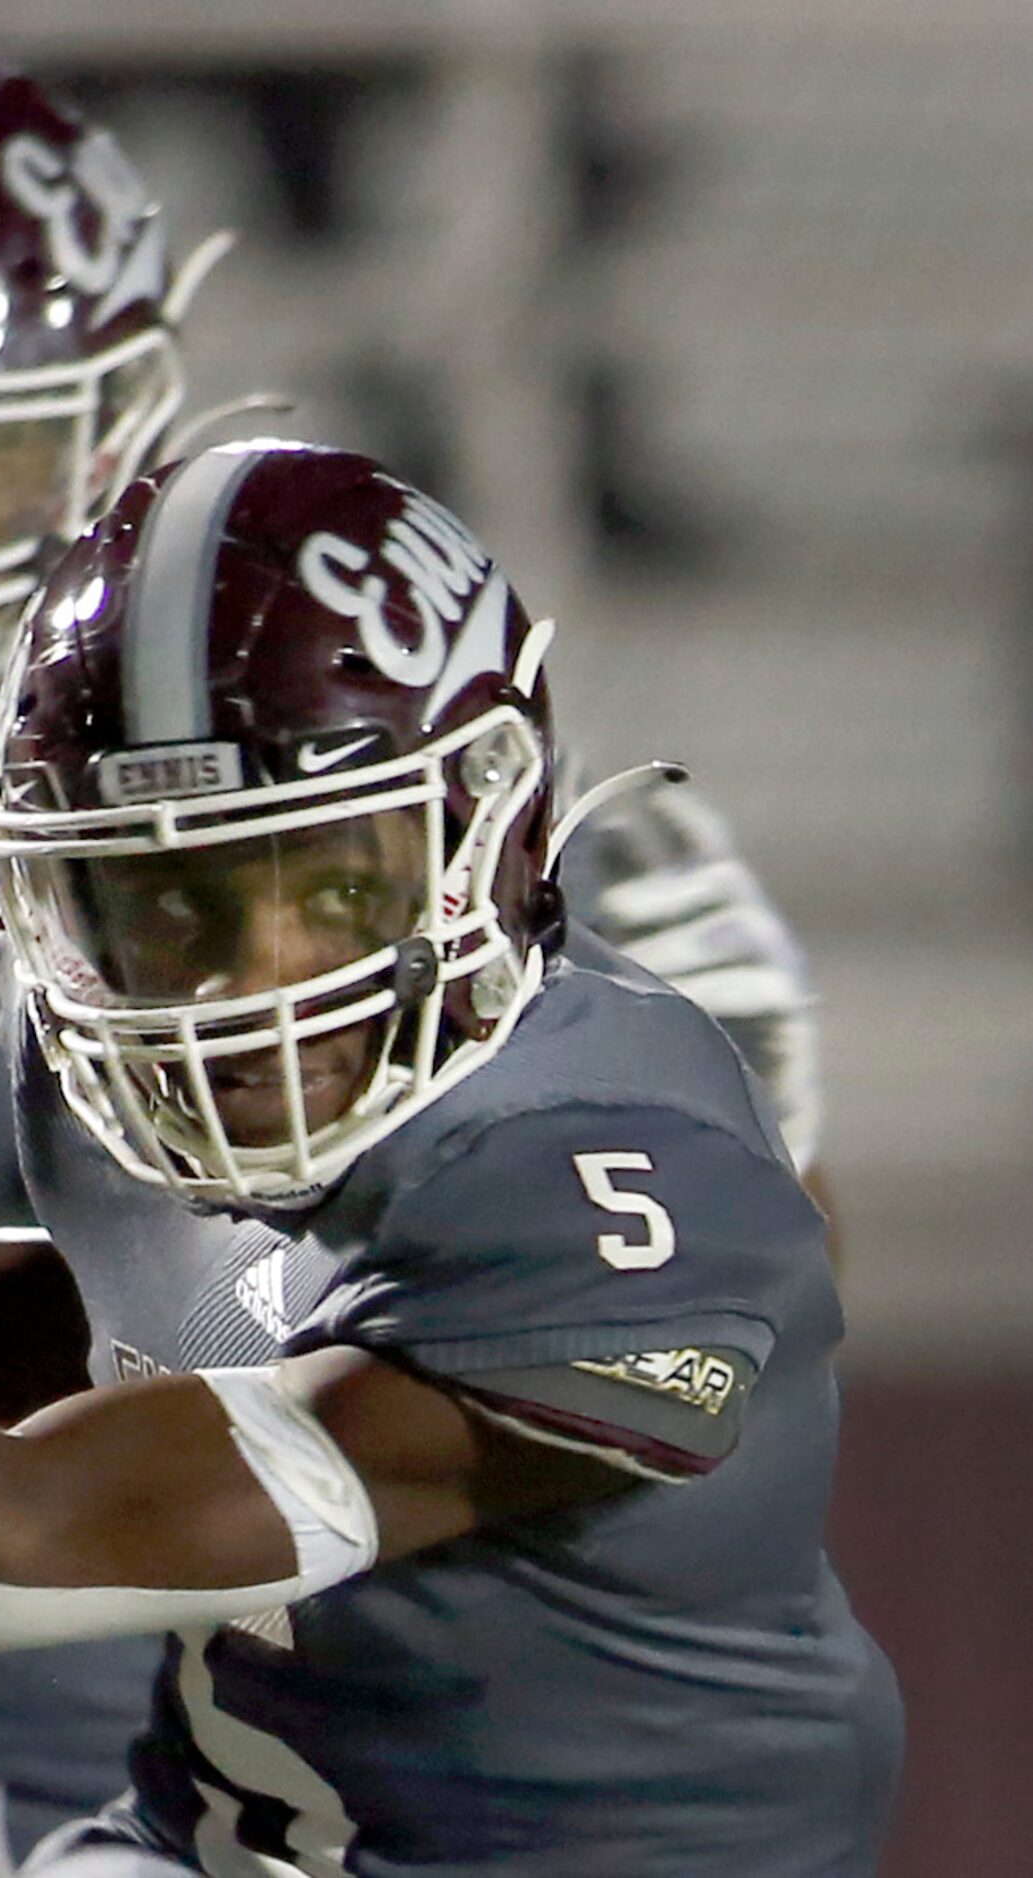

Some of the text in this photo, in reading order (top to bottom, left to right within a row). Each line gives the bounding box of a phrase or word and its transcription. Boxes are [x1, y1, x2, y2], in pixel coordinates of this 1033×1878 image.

[118, 753, 221, 797] ENNIS
[572, 1150, 676, 1270] 5
[235, 1276, 292, 1344] adidas
[571, 1348, 735, 1416] EAR
